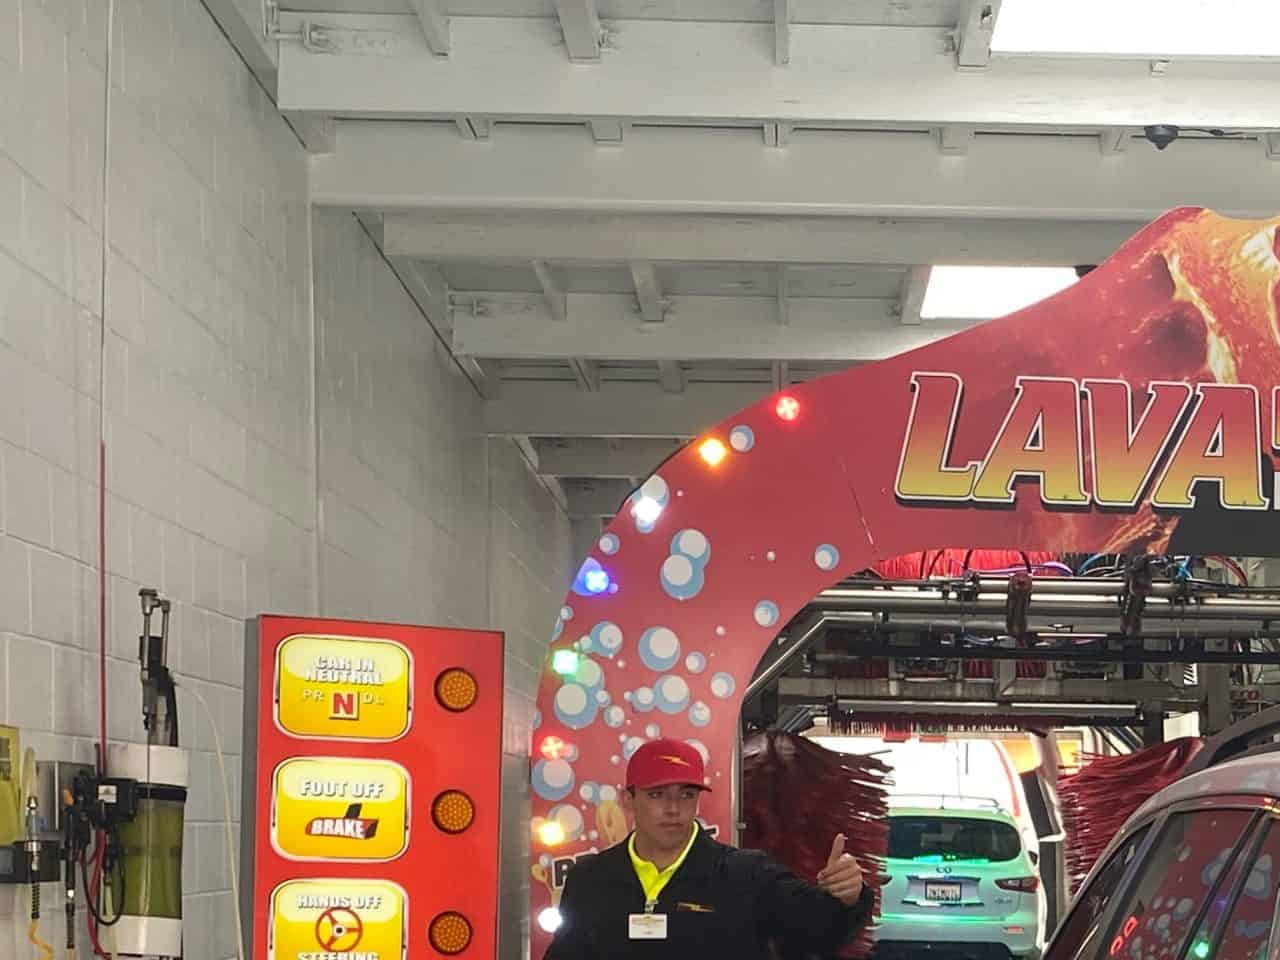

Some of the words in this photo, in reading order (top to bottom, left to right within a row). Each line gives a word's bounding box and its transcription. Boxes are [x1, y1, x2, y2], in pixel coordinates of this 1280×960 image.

[895, 371, 1272, 511] LAVA
[355, 657, 376, 673] IN
[304, 669, 385, 687] NEUTRAL
[352, 782, 385, 799] OFF
[310, 818, 367, 839] BRAKE
[298, 895, 351, 910] HANDS
[355, 896, 383, 910] OFF
